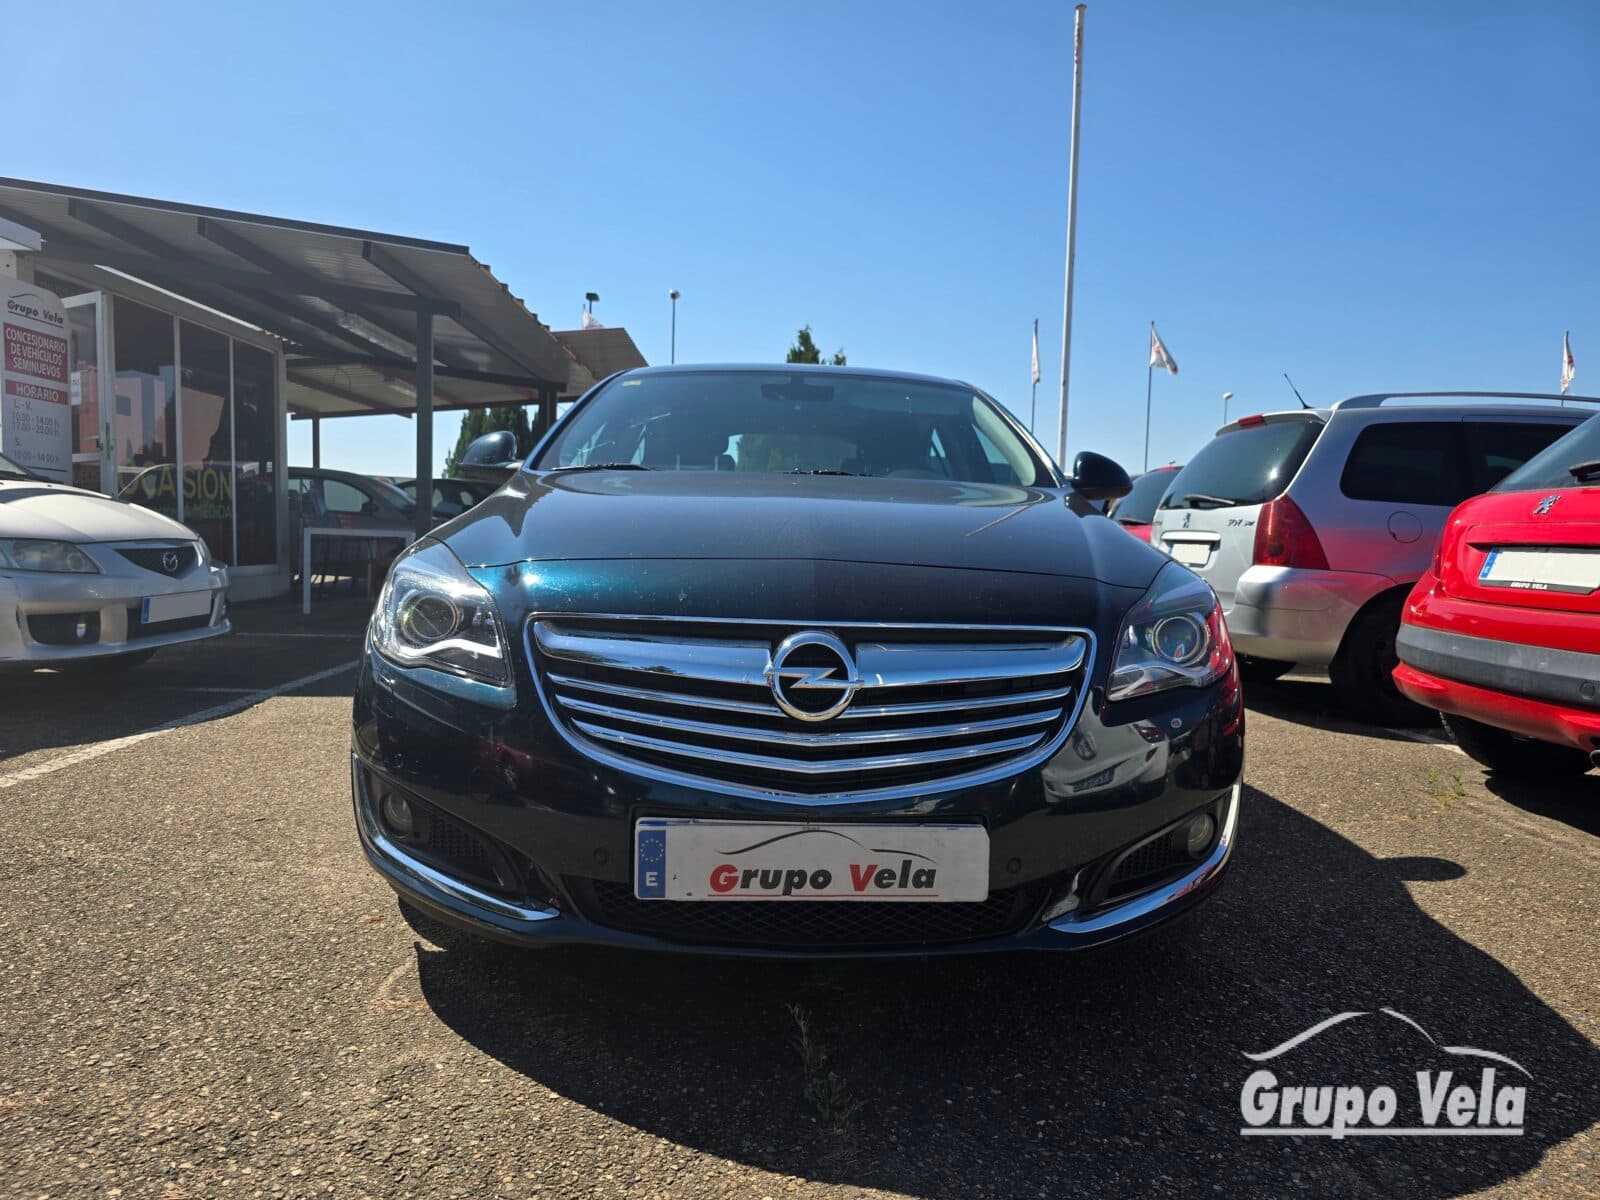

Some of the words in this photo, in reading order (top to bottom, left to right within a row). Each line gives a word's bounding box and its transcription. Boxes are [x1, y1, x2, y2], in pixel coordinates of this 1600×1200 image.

[8, 300, 38, 316] Grupo
[43, 309, 64, 324] Vela
[6, 327, 66, 353] CONCESIONARIO
[11, 342, 21, 355] DE
[13, 356, 61, 378] SEMINUEVOS
[16, 383, 59, 402] HORARIO
[645, 871, 658, 887] E
[709, 863, 833, 897] Grupo
[849, 859, 937, 892] Vela
